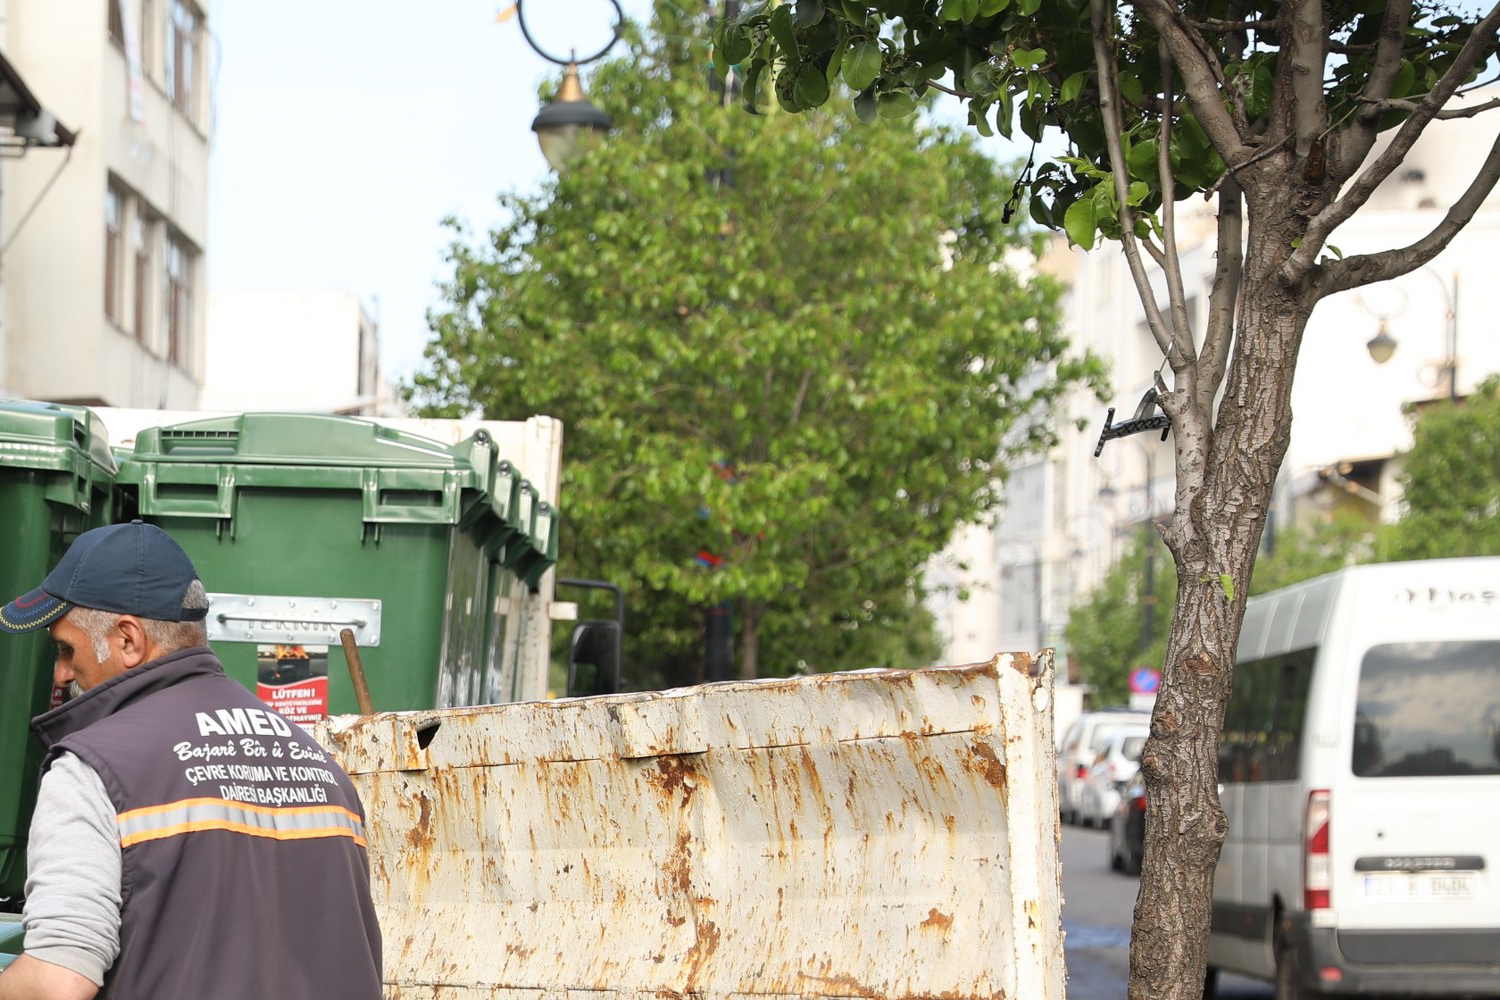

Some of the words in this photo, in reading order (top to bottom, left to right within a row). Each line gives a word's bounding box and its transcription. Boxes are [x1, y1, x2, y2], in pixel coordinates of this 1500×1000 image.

[296, 706, 308, 714] VE
[195, 708, 293, 738] AMED
[173, 740, 238, 762] Bajarê
[240, 738, 268, 758] Bîr
[272, 741, 284, 758] û
[185, 764, 229, 786] ÇEVRE
[228, 764, 272, 782] KORUMA
[272, 766, 289, 782] VE
[289, 766, 339, 787] KONTROL
[220, 782, 257, 803] DAİRESİ
[255, 784, 328, 807] BAŞKANLIĞI
